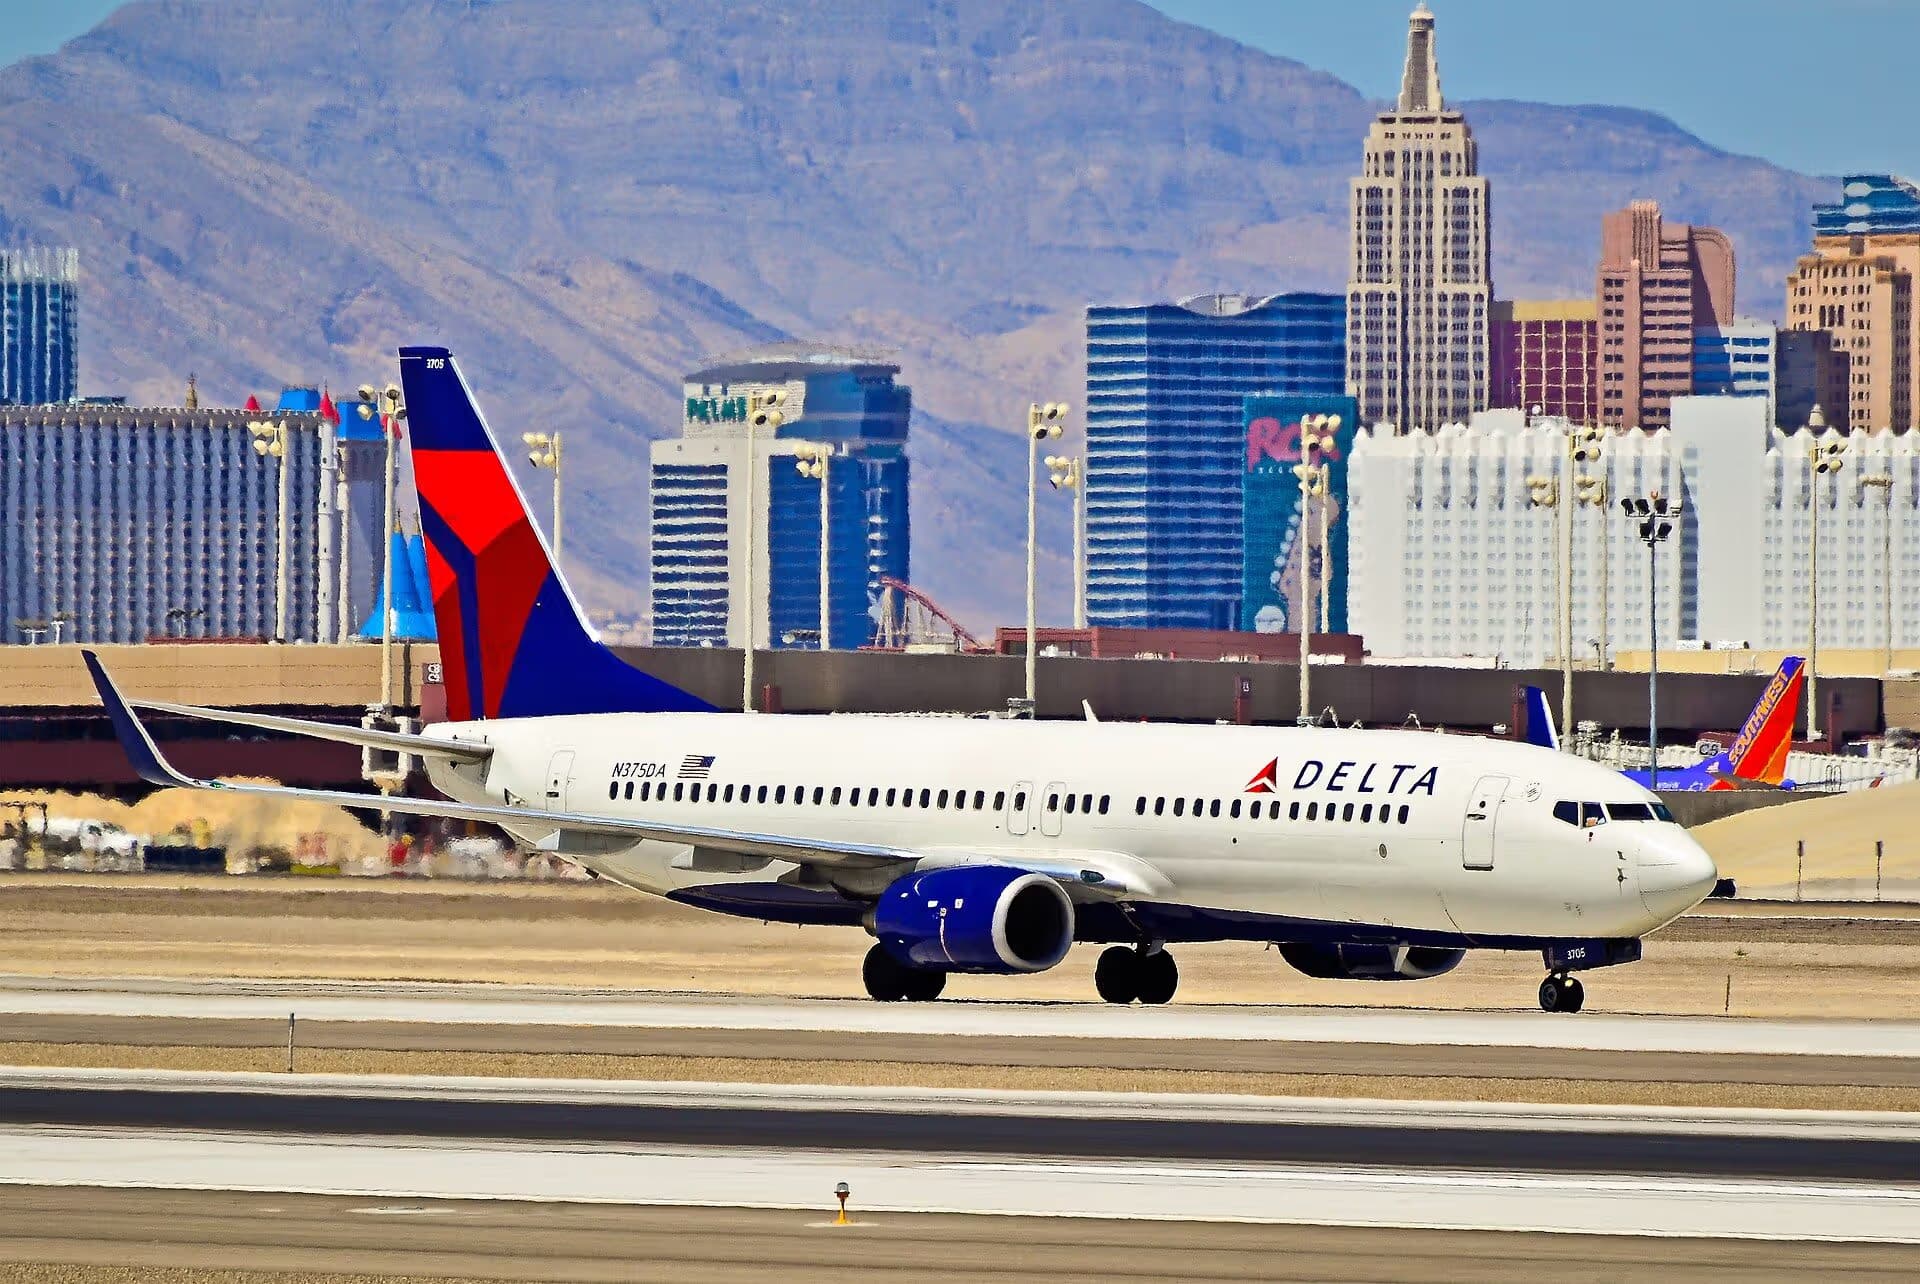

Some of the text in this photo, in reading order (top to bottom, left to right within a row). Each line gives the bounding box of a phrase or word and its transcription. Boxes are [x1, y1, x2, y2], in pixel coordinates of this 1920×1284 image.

[426, 358, 445, 369] 3705
[1729, 668, 1788, 765] SOUTHWEST
[612, 762, 666, 778] N375DA
[1293, 760, 1439, 796] DELTA
[1567, 947, 1586, 960] 3705
